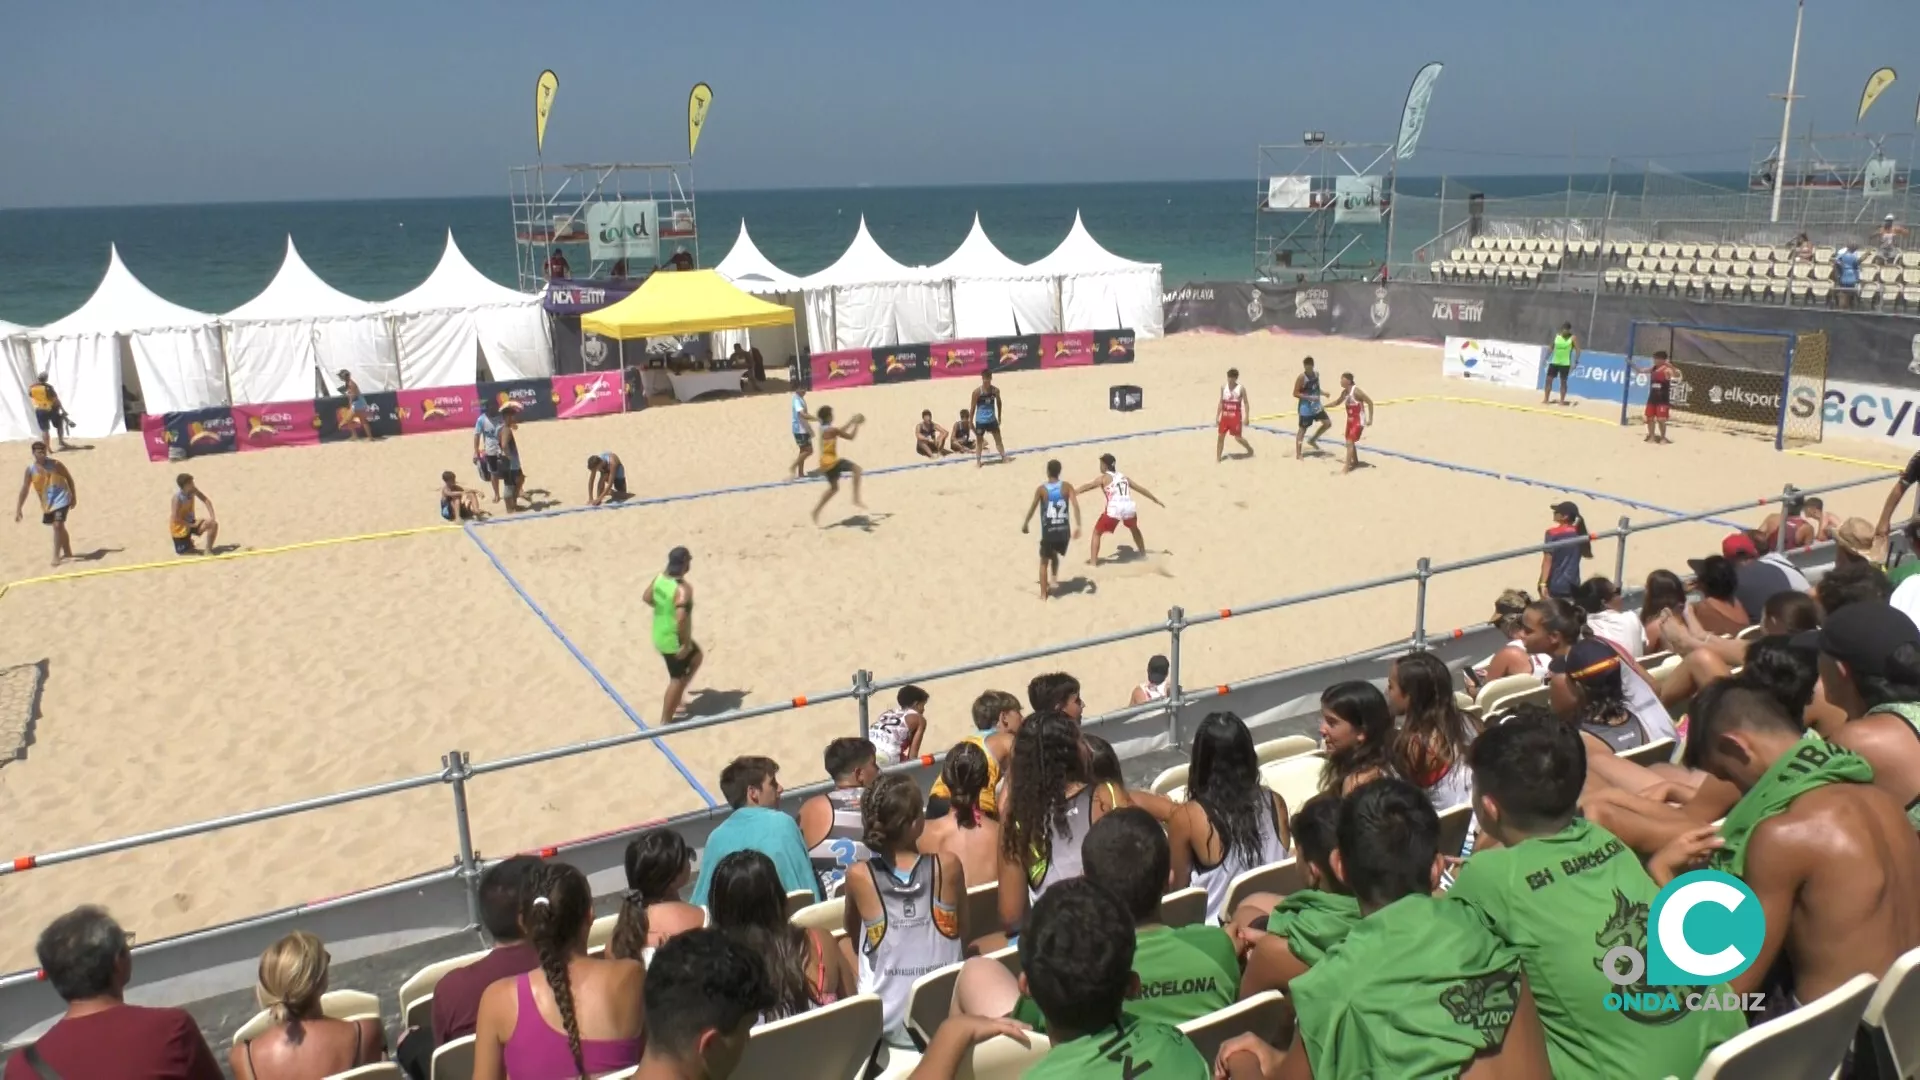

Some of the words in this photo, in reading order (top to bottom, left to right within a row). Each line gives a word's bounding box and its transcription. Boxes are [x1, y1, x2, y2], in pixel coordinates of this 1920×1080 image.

[1724, 386, 1781, 408] elksport
[1116, 481, 1129, 497] 17
[1046, 499, 1068, 518] 42
[1138, 976, 1217, 1000] RCELONA
